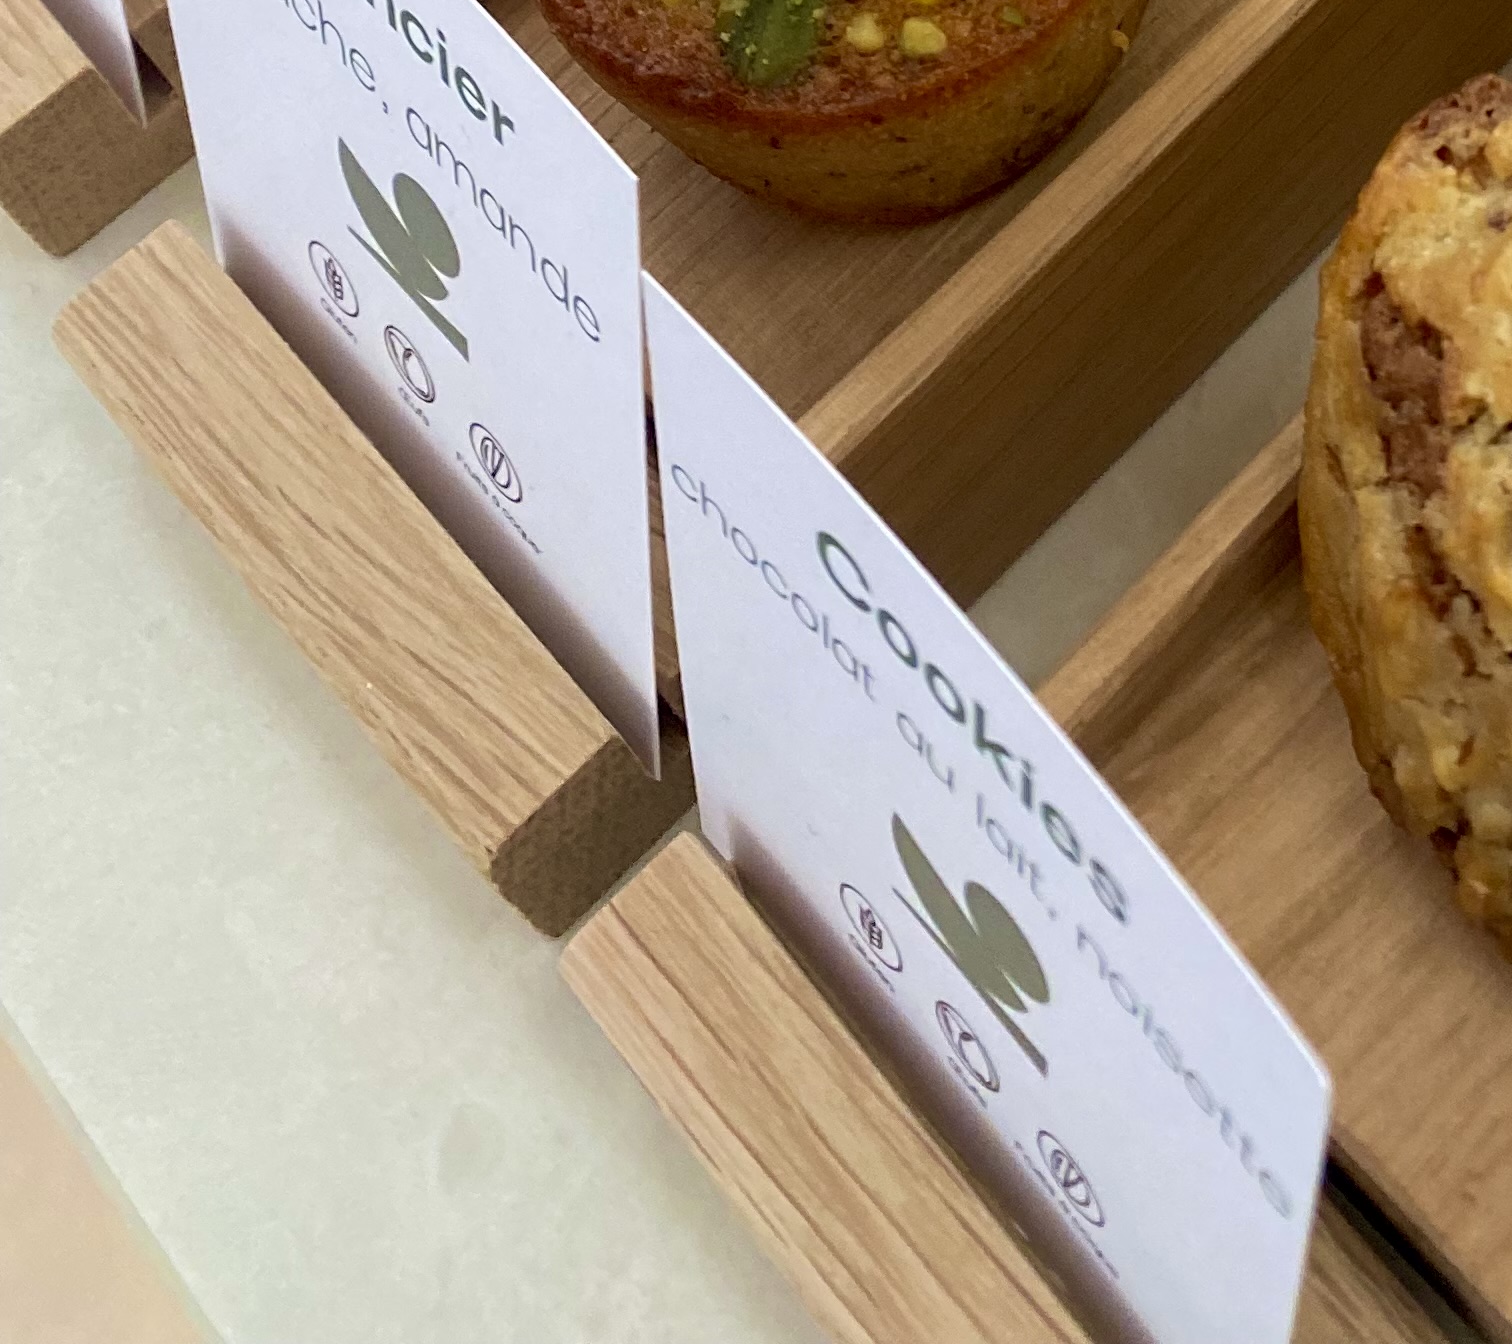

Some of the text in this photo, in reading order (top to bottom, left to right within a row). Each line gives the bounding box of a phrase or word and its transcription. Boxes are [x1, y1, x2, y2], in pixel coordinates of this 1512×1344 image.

[406, 106, 601, 343] amande
[671, 463, 878, 703] chocolat
[896, 711, 955, 793] au
[815, 530, 1129, 926] Cookies
